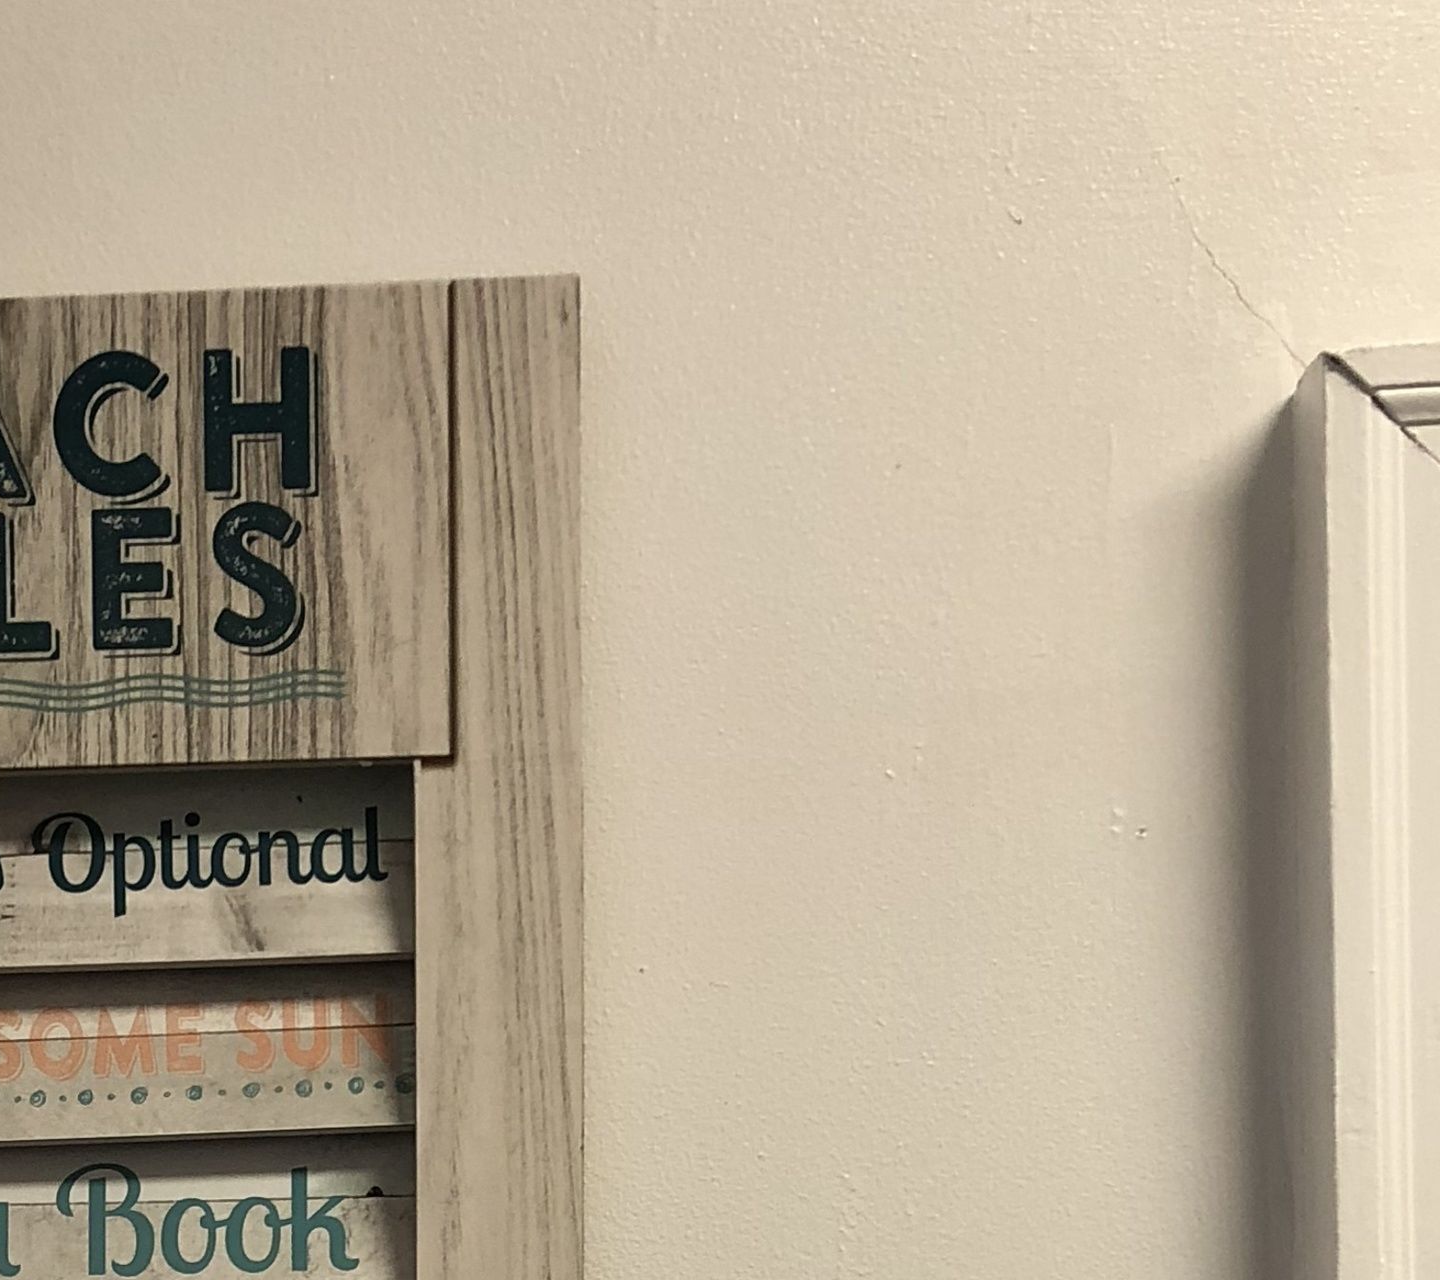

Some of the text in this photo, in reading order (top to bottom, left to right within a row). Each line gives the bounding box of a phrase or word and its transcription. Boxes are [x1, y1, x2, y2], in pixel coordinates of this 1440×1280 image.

[31, 805, 388, 916] Optional
[235, 993, 390, 1072] SUN
[56, 1162, 360, 1277] Book
